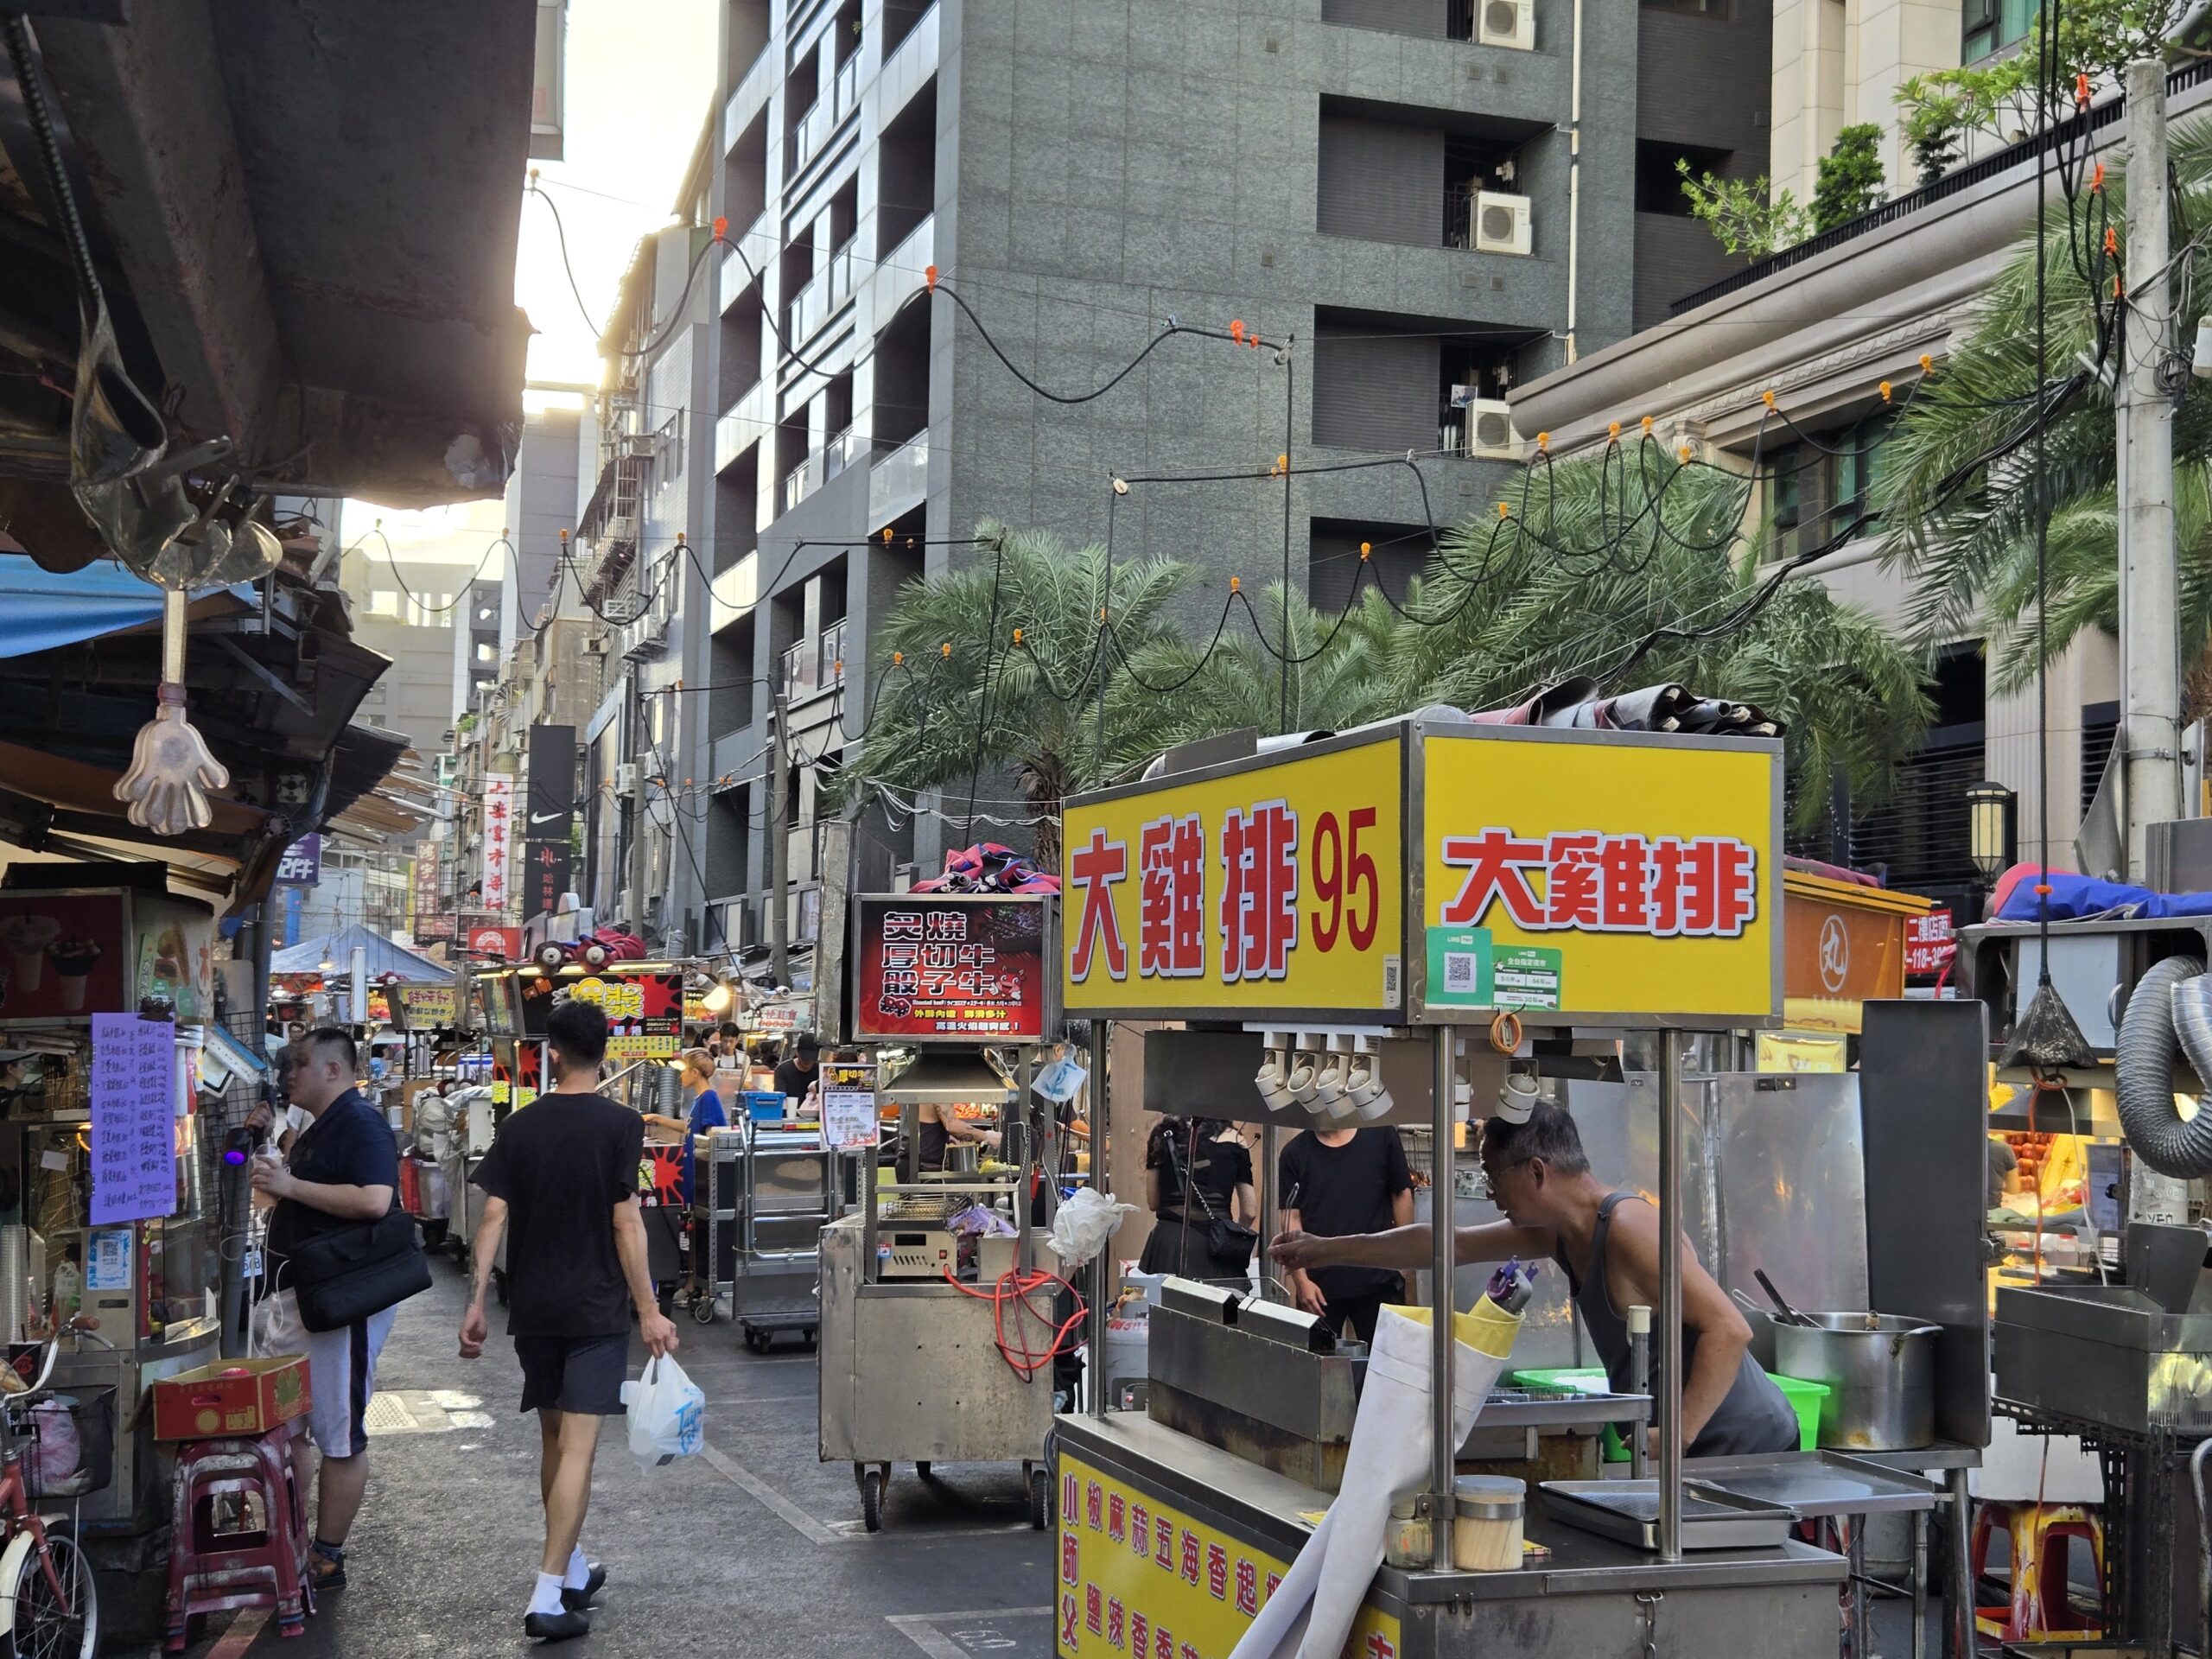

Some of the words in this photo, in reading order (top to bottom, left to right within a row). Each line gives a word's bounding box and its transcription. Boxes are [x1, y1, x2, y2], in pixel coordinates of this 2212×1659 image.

[883, 911, 967, 940] 炙燒
[1071, 798, 1298, 983] 大雞排
[1310, 806, 1379, 953] 95
[1442, 826, 1758, 936] 大雞排
[881, 943, 995, 968] 厚切牛
[882, 970, 995, 995] 骰子牛
[1062, 1471, 1079, 1652] 小師父
[1109, 1491, 1125, 1650] 麻辣
